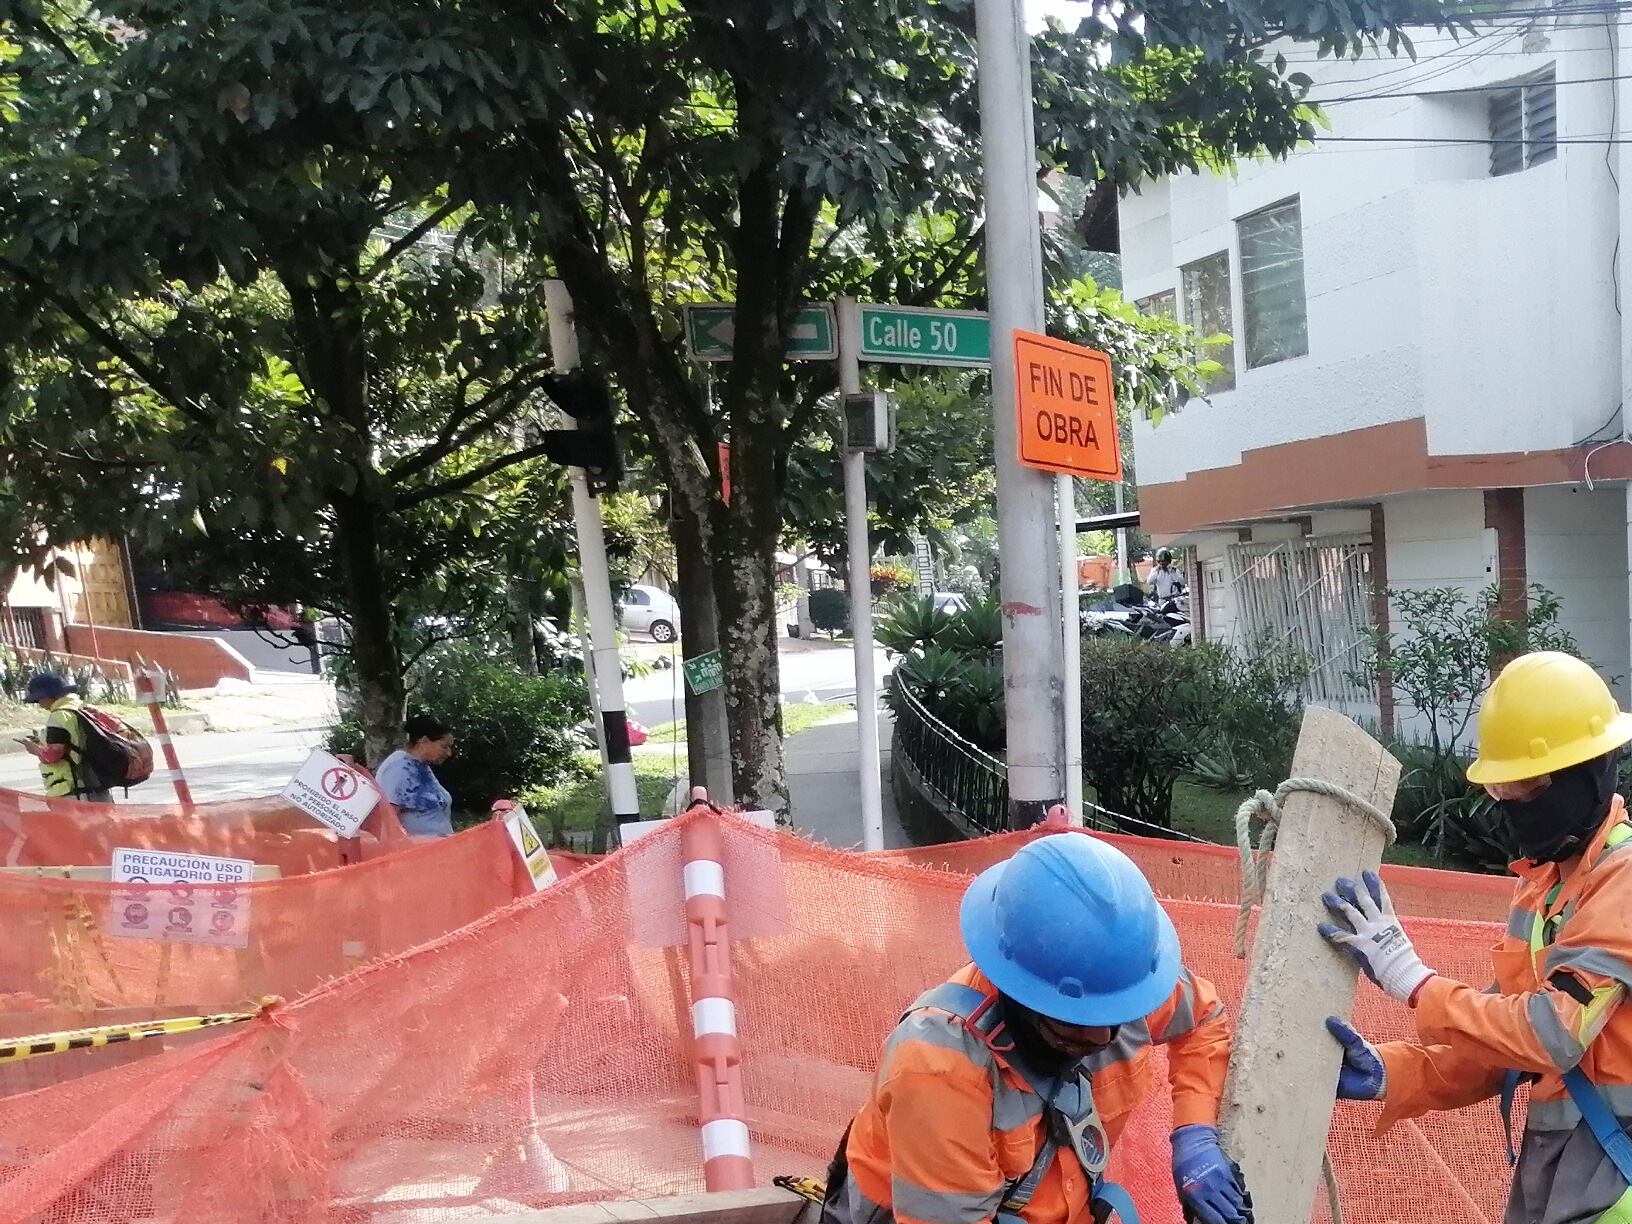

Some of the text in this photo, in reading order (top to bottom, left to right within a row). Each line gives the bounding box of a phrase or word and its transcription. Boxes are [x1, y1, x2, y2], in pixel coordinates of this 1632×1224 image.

[870, 316, 957, 352] Calle 50
[1029, 362, 1098, 405] FIN DE
[1036, 410, 1100, 450] OBRA
[290, 793, 346, 831] NO AUTORIZADO
[294, 778, 359, 823] PROHIBIDO EL PASO
[308, 797, 342, 821] PERSONAL
[122, 864, 242, 883] OBLIGATORIO EPP
[215, 863, 243, 874] USO
